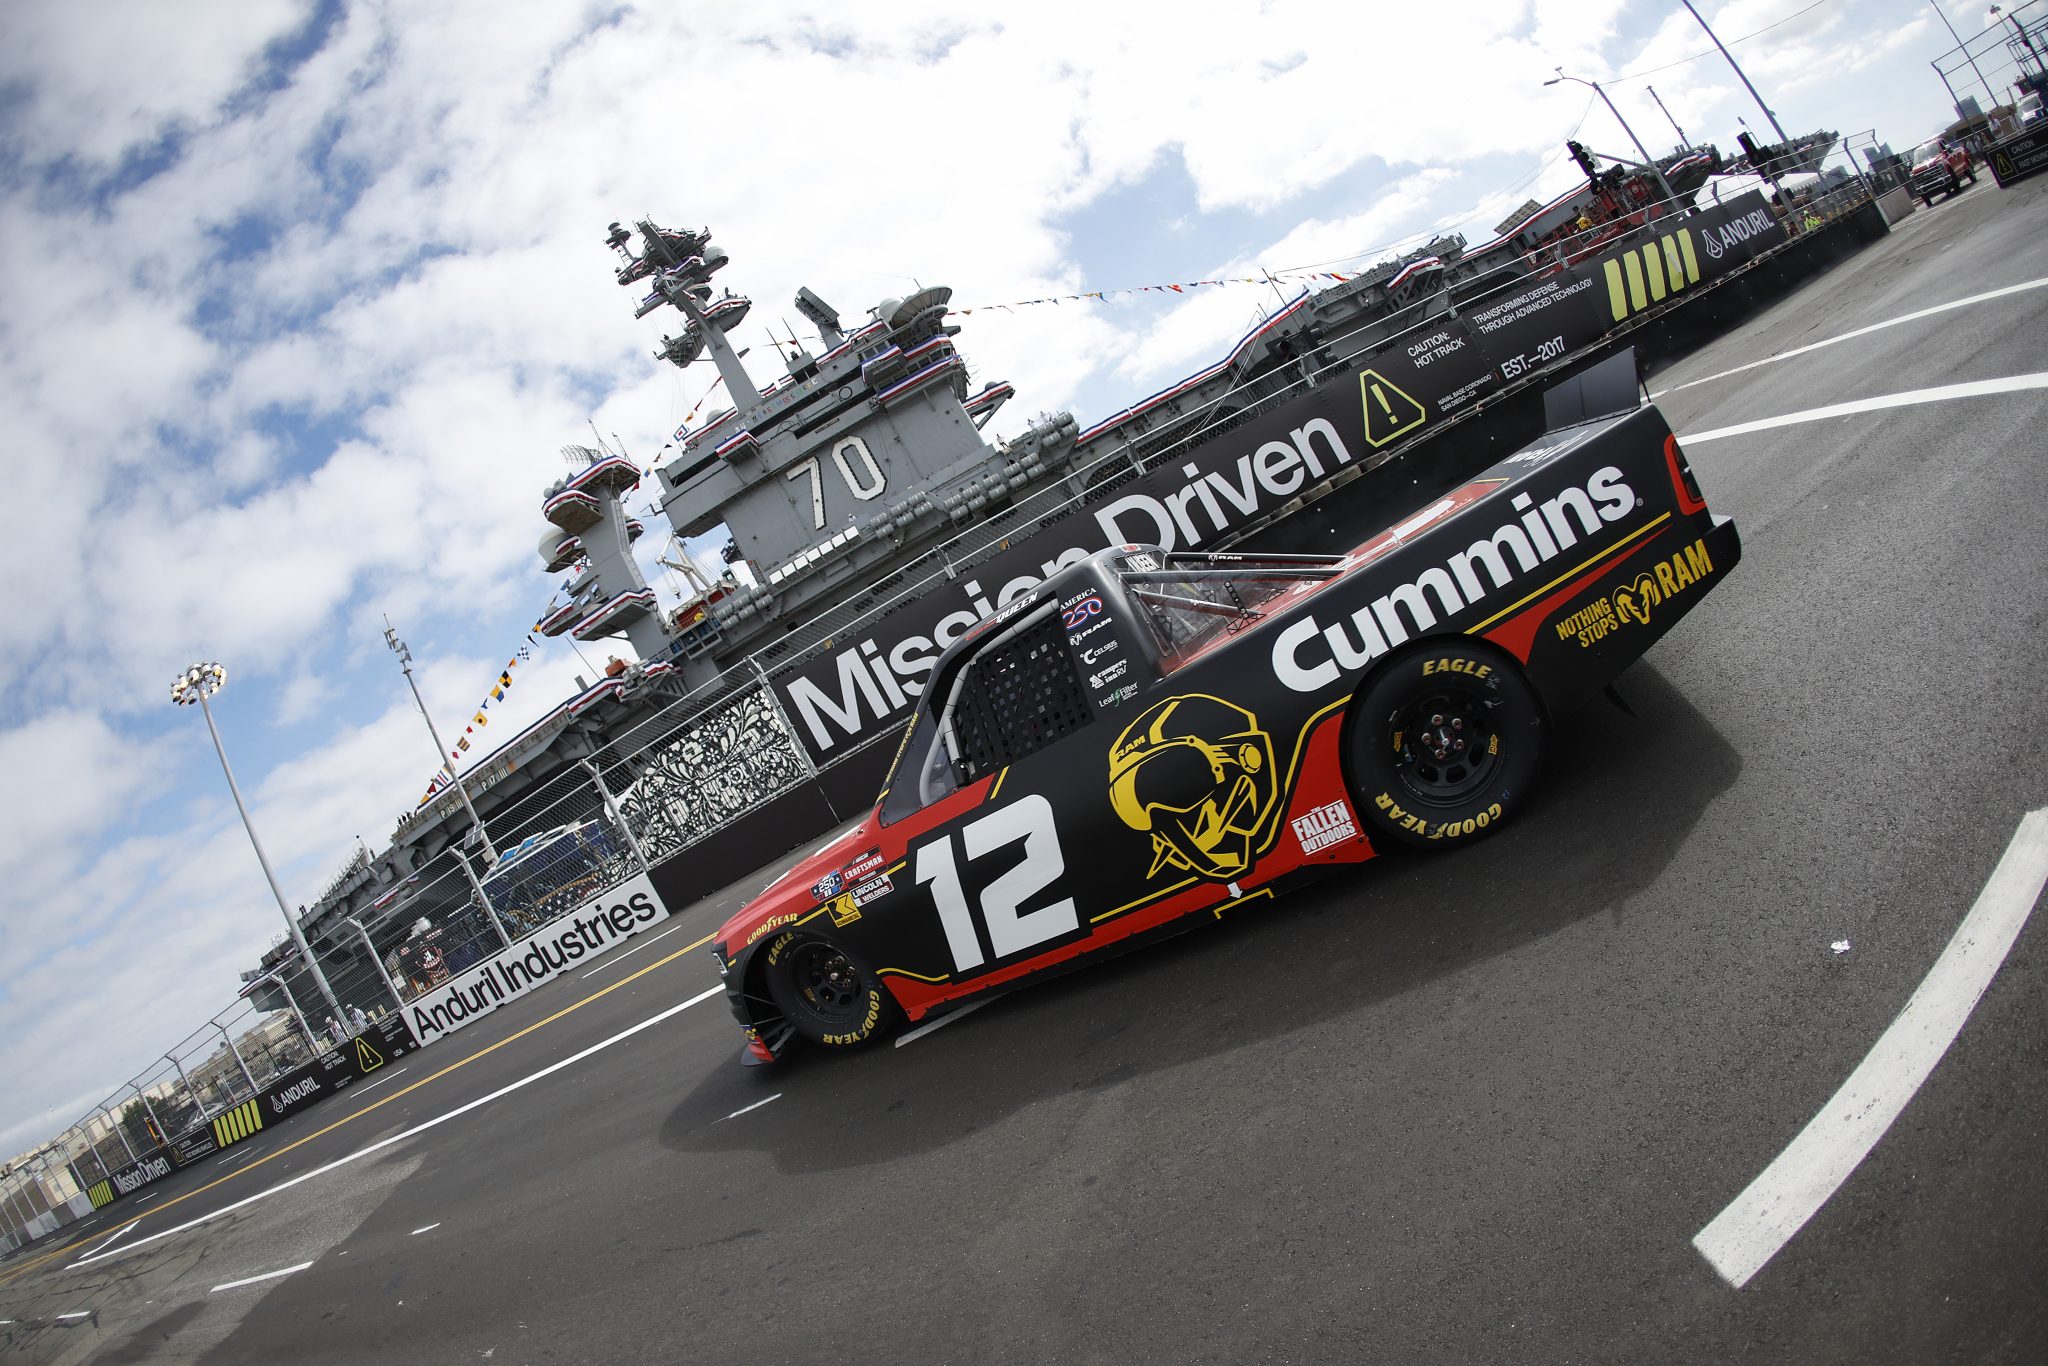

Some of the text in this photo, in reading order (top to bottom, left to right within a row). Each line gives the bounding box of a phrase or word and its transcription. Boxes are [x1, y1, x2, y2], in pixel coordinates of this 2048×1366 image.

[1719, 208, 1775, 249] ANDURIL
[1472, 281, 1560, 325] TRANSFORMING DEFENSE
[1479, 277, 1594, 335] THROUGH ADVANCED TECHNOLOGY
[1407, 331, 1451, 357] CAUTION:
[1413, 337, 1466, 369] HOT TRACK
[1437, 374, 1492, 406] NAVAL BASE CORONADO
[1440, 401, 1452, 412] SAN
[785, 435, 888, 531] 70
[1094, 417, 1352, 554] Driven
[1271, 465, 1636, 693] Cummins
[1653, 538, 1714, 599] RAM
[996, 592, 1038, 624] QUEEN
[1060, 587, 1097, 612] AMERICA
[1062, 596, 1103, 630] 250
[1082, 617, 1113, 637] RAM
[1555, 597, 1612, 641] NOTHING
[1577, 613, 1619, 648] STOPS
[1093, 640, 1118, 657] CELSIUS
[1097, 658, 1128, 678] campers
[1422, 658, 1493, 679] EAGLE
[1116, 735, 1146, 761] RAM
[1291, 801, 1351, 842] FALLEN
[1374, 791, 1503, 840] GOODYEAR
[1300, 821, 1356, 853] OUTDOORS
[844, 855, 884, 880] CRAFTSMAN
[915, 793, 1080, 973] 12
[818, 878, 836, 893] 250
[851, 879, 884, 899] LINCOLN
[861, 886, 890, 903] WELDERS
[746, 912, 799, 945] GOODYEAR
[767, 931, 795, 967] EAGLE
[412, 892, 657, 1041] Anduril Industries
[823, 990, 880, 1045] GOODYEAR
[280, 1076, 321, 1107] ANDURIL
[113, 1156, 171, 1196] Mission Driven
